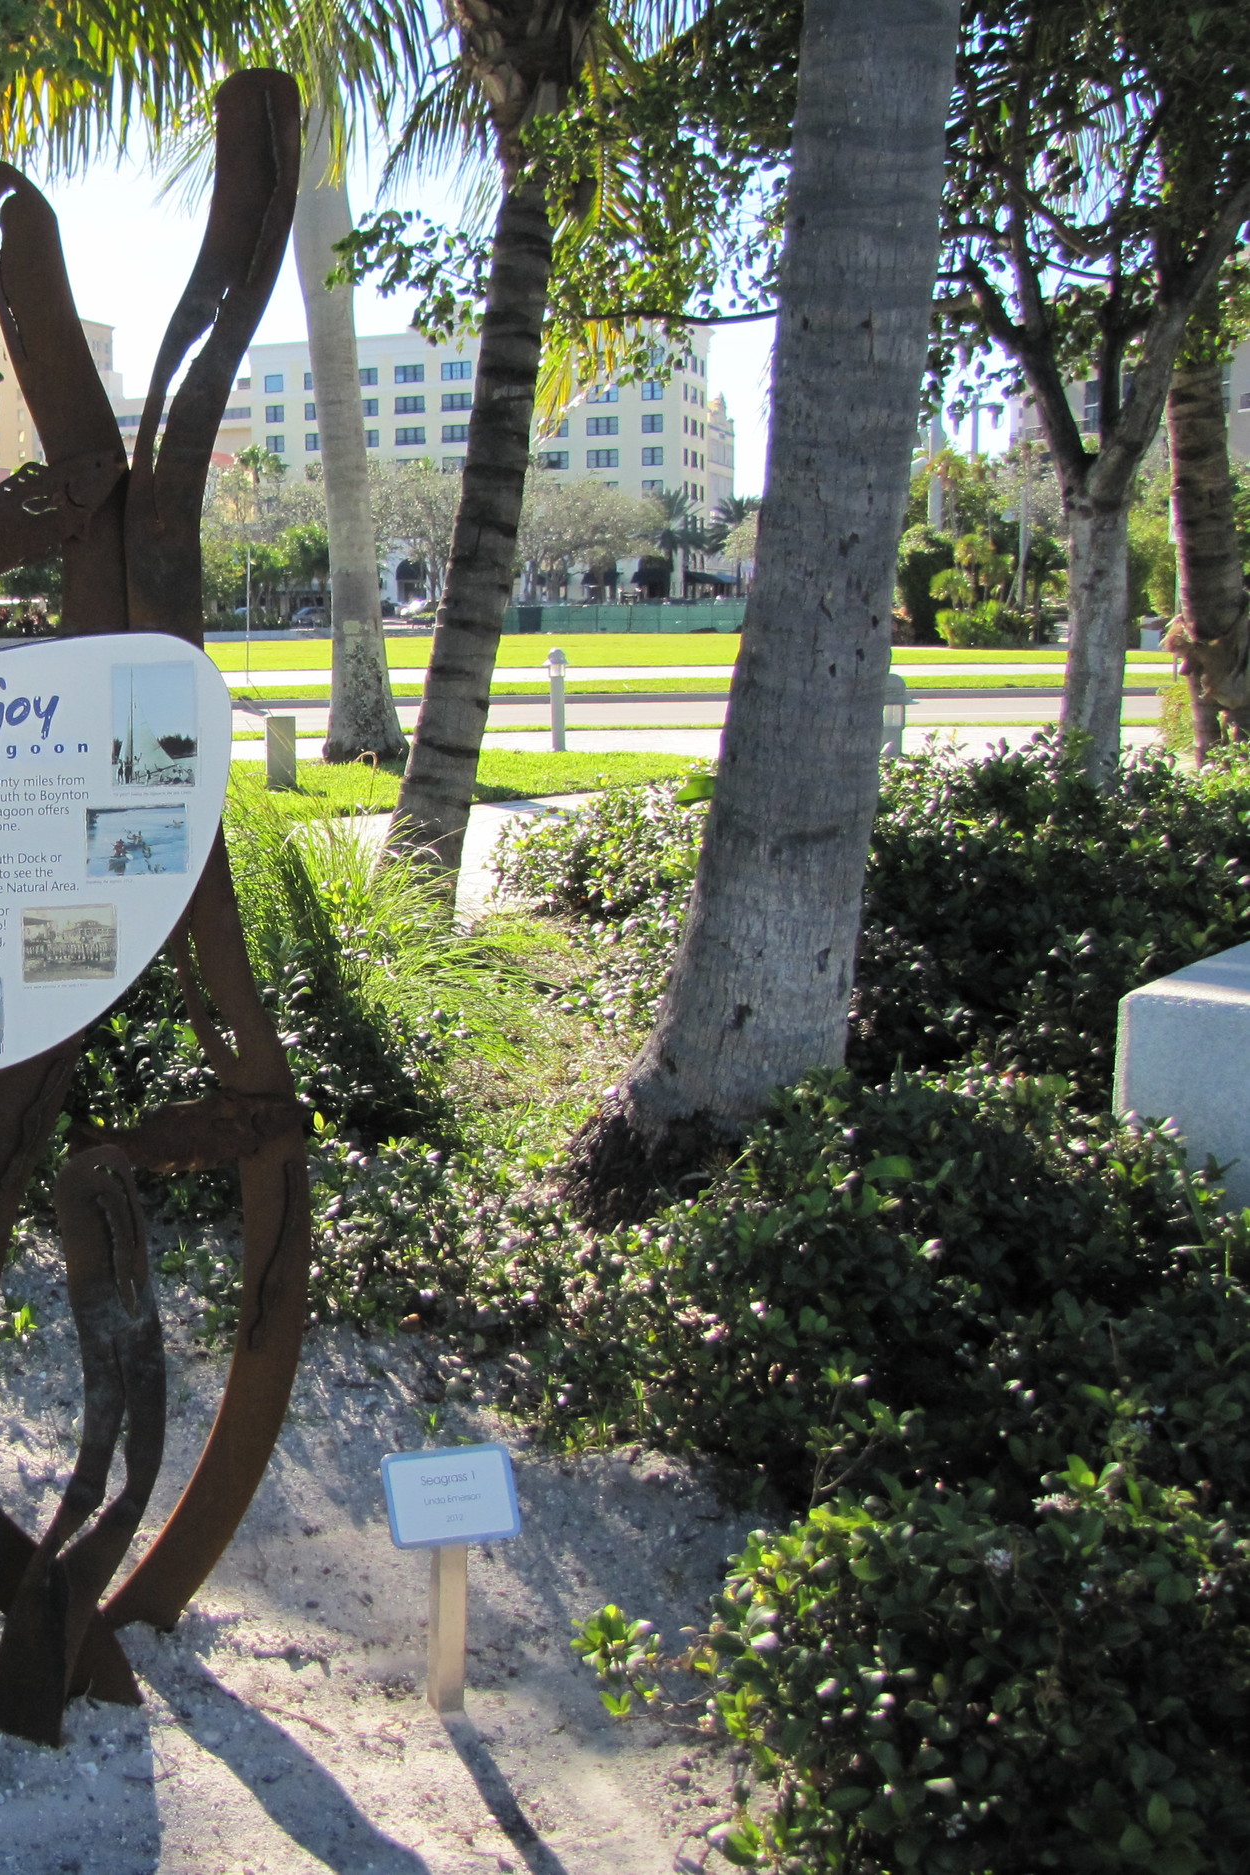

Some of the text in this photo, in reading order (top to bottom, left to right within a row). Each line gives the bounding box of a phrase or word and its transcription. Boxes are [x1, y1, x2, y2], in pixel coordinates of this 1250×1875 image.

[24, 776, 54, 787] miles
[57, 775, 85, 786] from
[24, 791, 36, 802] to
[40, 790, 89, 804] Boynton
[38, 804, 70, 816] offers
[18, 852, 46, 864] Dock
[50, 854, 62, 863] or
[0, 869, 10, 879] to
[14, 870, 32, 879] see
[36, 867, 54, 878] the
[6, 881, 48, 893] Natural
[51, 881, 79, 892] Area.
[420, 1473, 468, 1486] Seagrass
[424, 1496, 446, 1505] Linda
